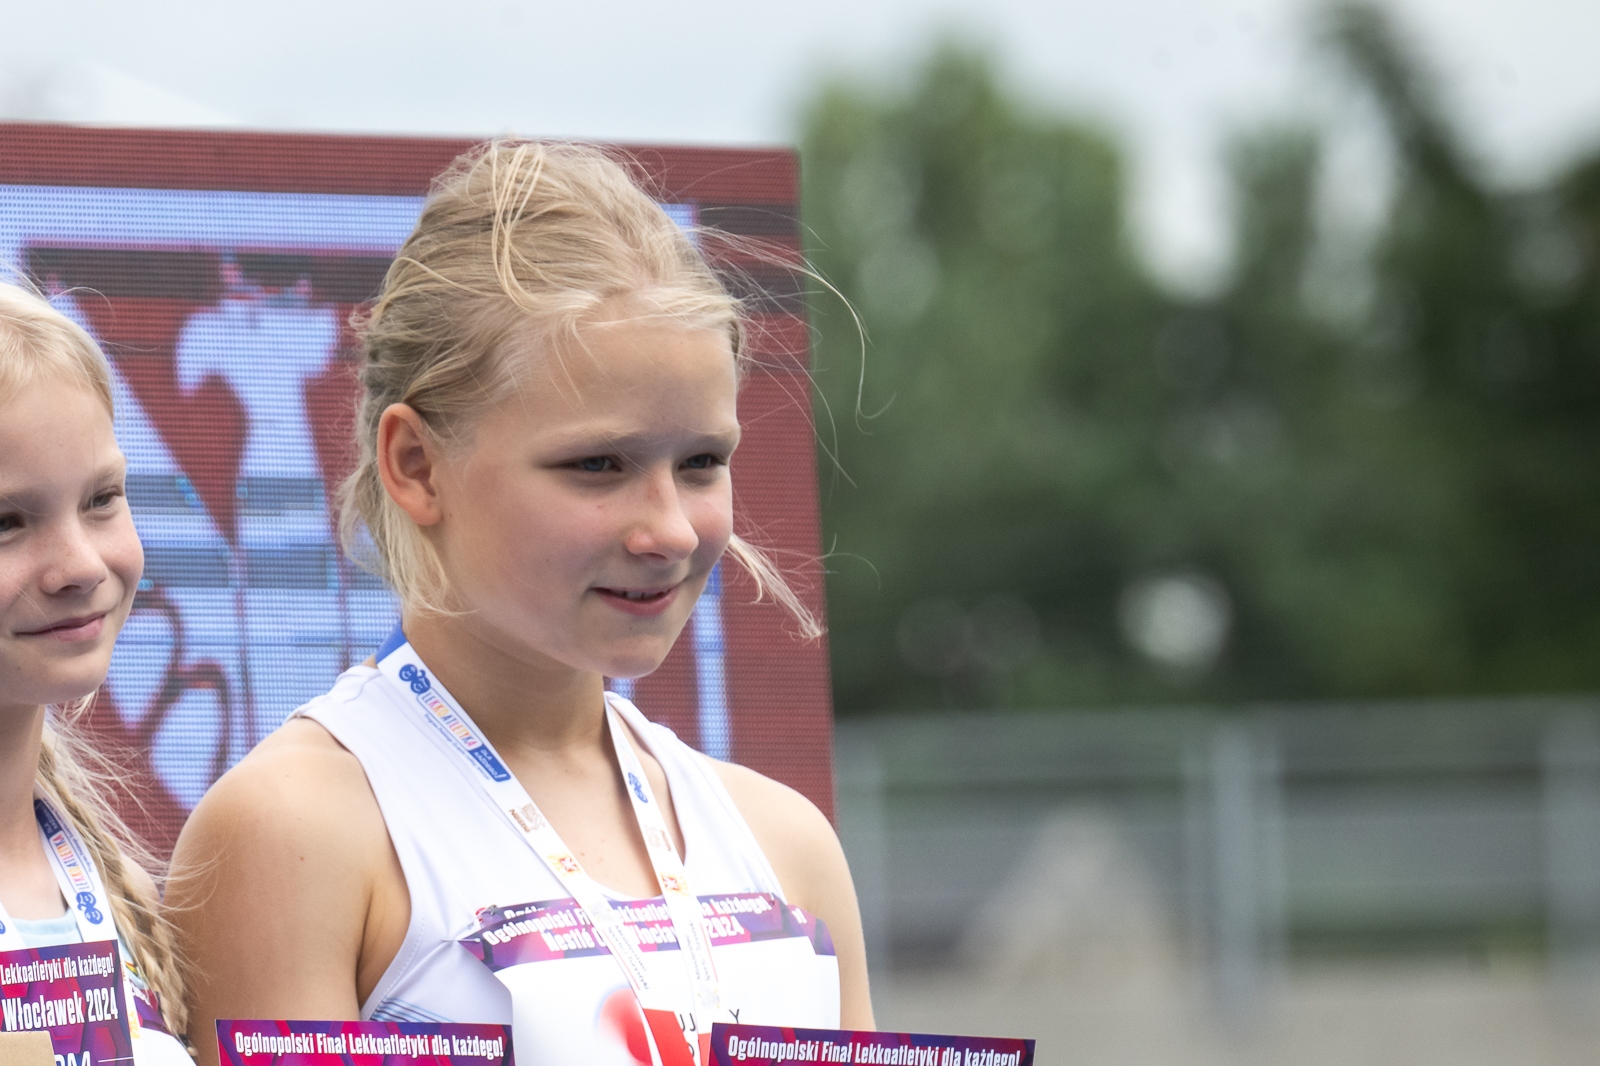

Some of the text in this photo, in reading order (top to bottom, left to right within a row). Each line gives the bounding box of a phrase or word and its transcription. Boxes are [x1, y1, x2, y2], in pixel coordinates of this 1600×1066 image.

[482, 909, 577, 946] Ogólnopolski
[0, 958, 62, 985] Lekkoatletyki
[64, 957, 78, 977] dla
[79, 953, 114, 978] każdego!
[2, 992, 86, 1032] Włocławek
[86, 987, 119, 1022] 2024
[235, 1031, 504, 1061] Ogólnopolski Finał Lekkoatletyki dla każdego!
[728, 1035, 819, 1062] Ogólnopolski
[821, 1040, 852, 1063] Finał
